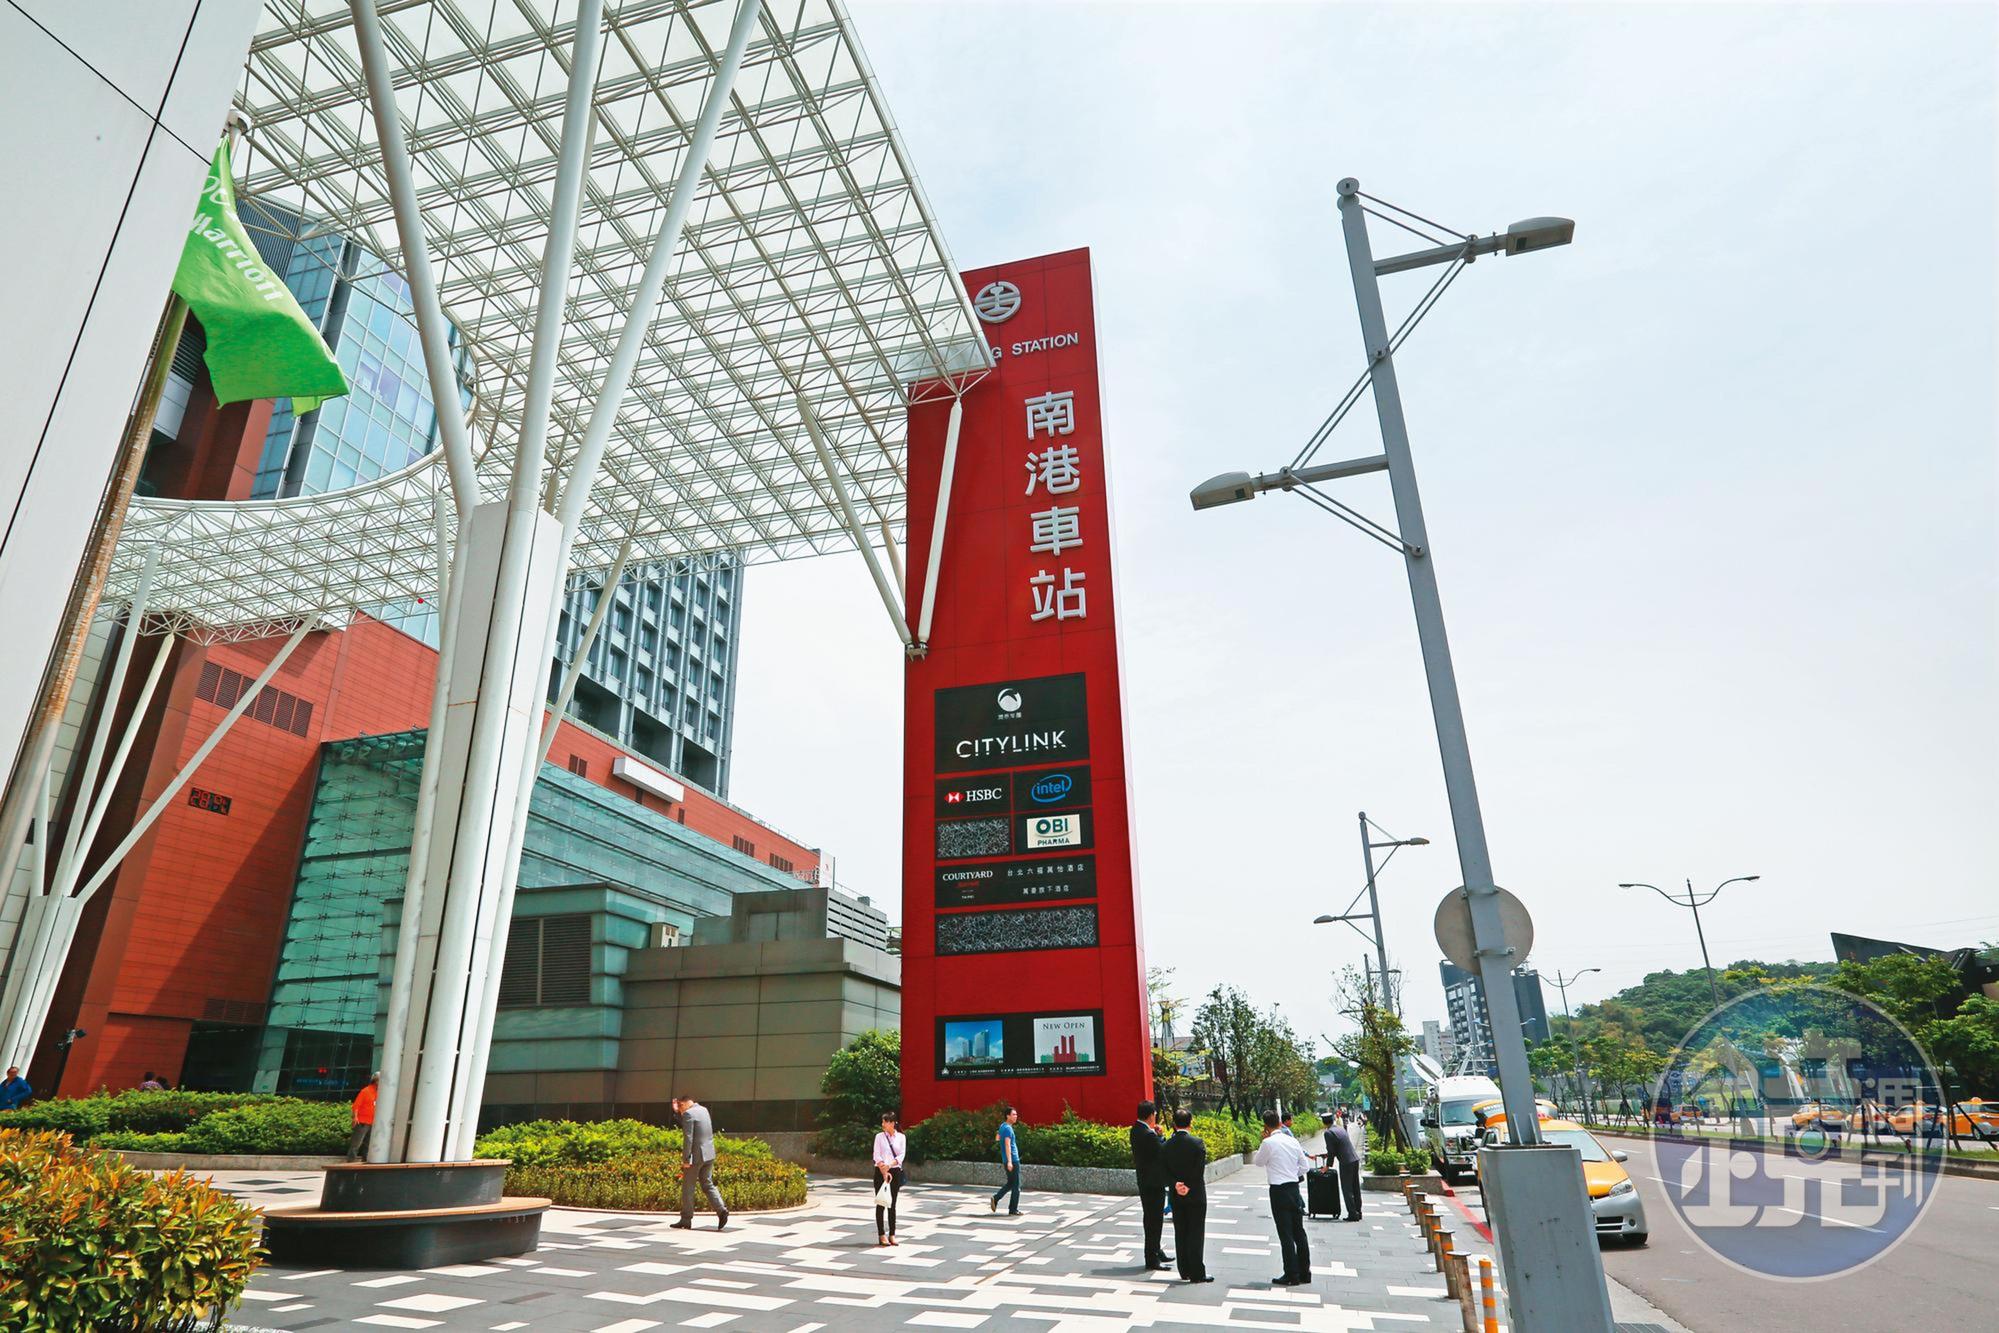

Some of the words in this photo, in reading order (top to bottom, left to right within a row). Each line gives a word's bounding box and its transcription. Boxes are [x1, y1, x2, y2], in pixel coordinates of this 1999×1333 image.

[1011, 332, 1079, 356] STATION
[1024, 390, 1087, 621] 南港車站
[956, 730, 1066, 758] CITYLINK
[965, 787, 1002, 802] HSBC
[1036, 779, 1067, 795] intel
[1035, 817, 1069, 835] OBI
[1037, 837, 1070, 847] PHARMA
[942, 870, 993, 881] COURTYARD
[1063, 1021, 1086, 1030] OPEN
